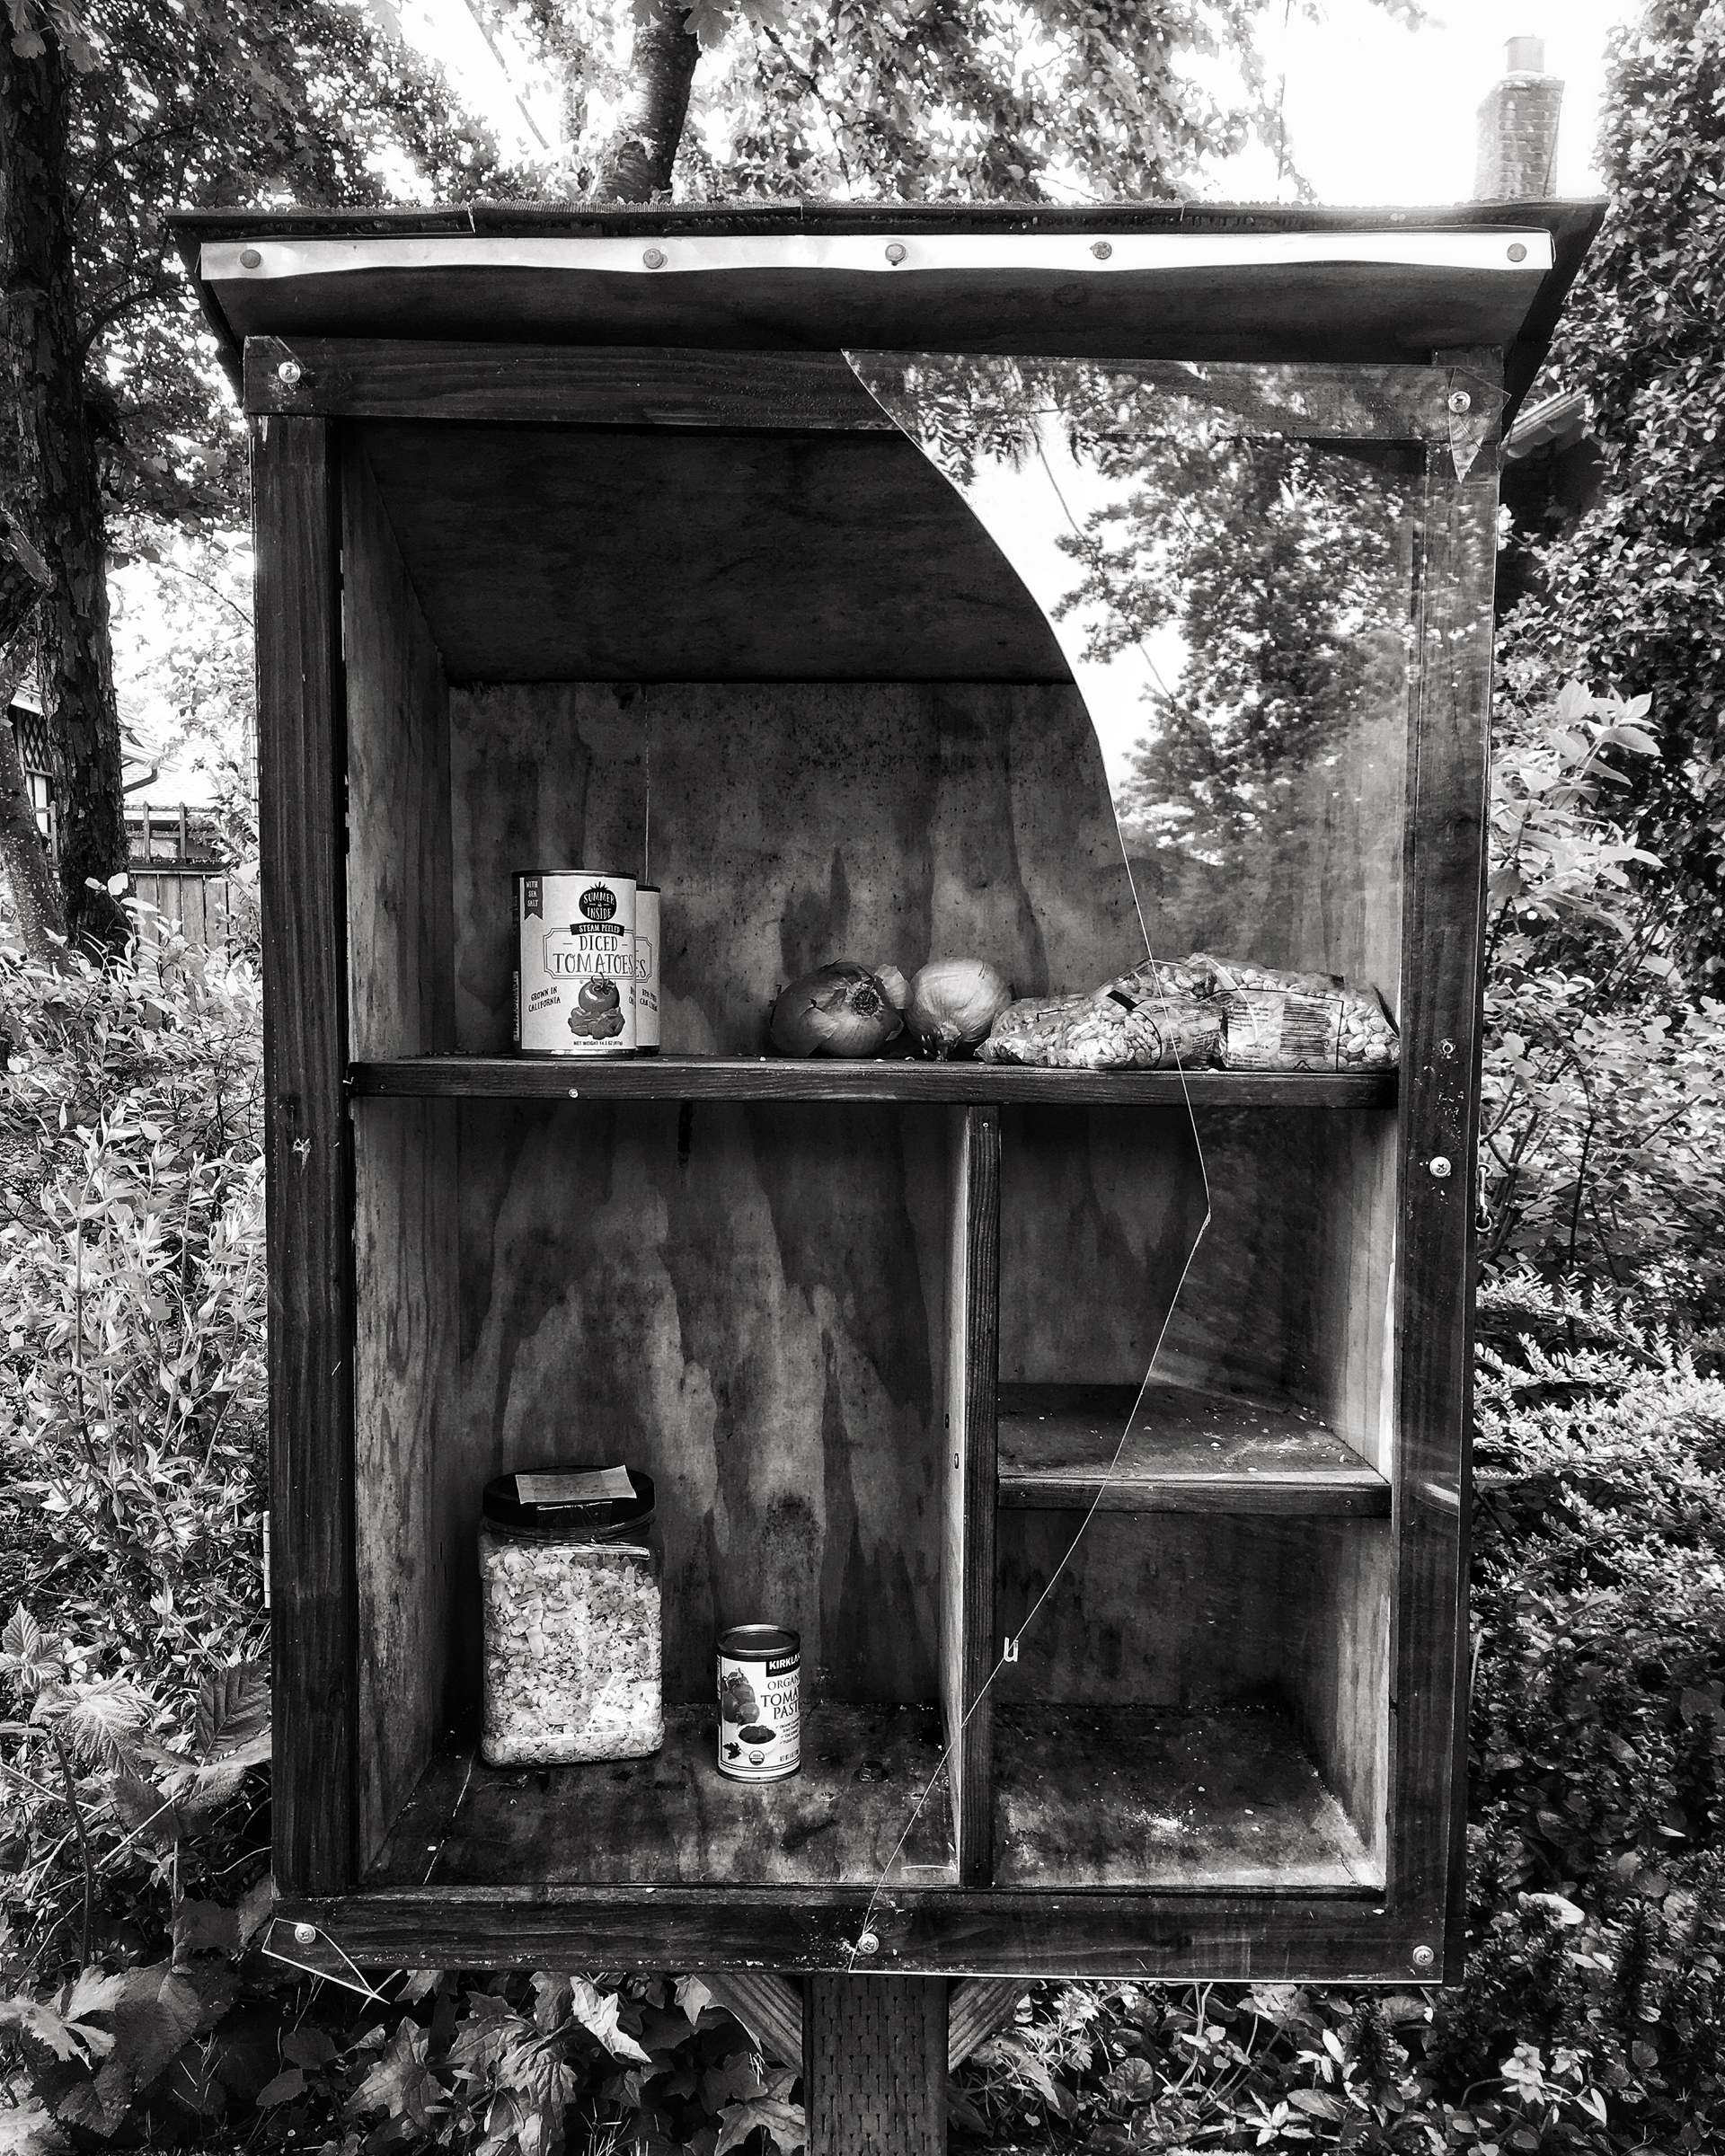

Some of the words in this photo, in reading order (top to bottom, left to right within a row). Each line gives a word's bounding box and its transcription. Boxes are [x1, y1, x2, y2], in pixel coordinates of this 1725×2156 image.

[584, 892, 615, 905] SUMMER
[587, 907, 612, 920] INSIDE
[579, 924, 600, 932] STEAM
[602, 924, 620, 934] PEELED
[579, 935, 618, 951] DICED
[553, 953, 633, 975] TOMATOES
[531, 988, 549, 1001] GROWN
[551, 985, 557, 994] IN
[528, 996, 562, 1012] CALIFORNIA
[760, 1685, 800, 1708] TOMA
